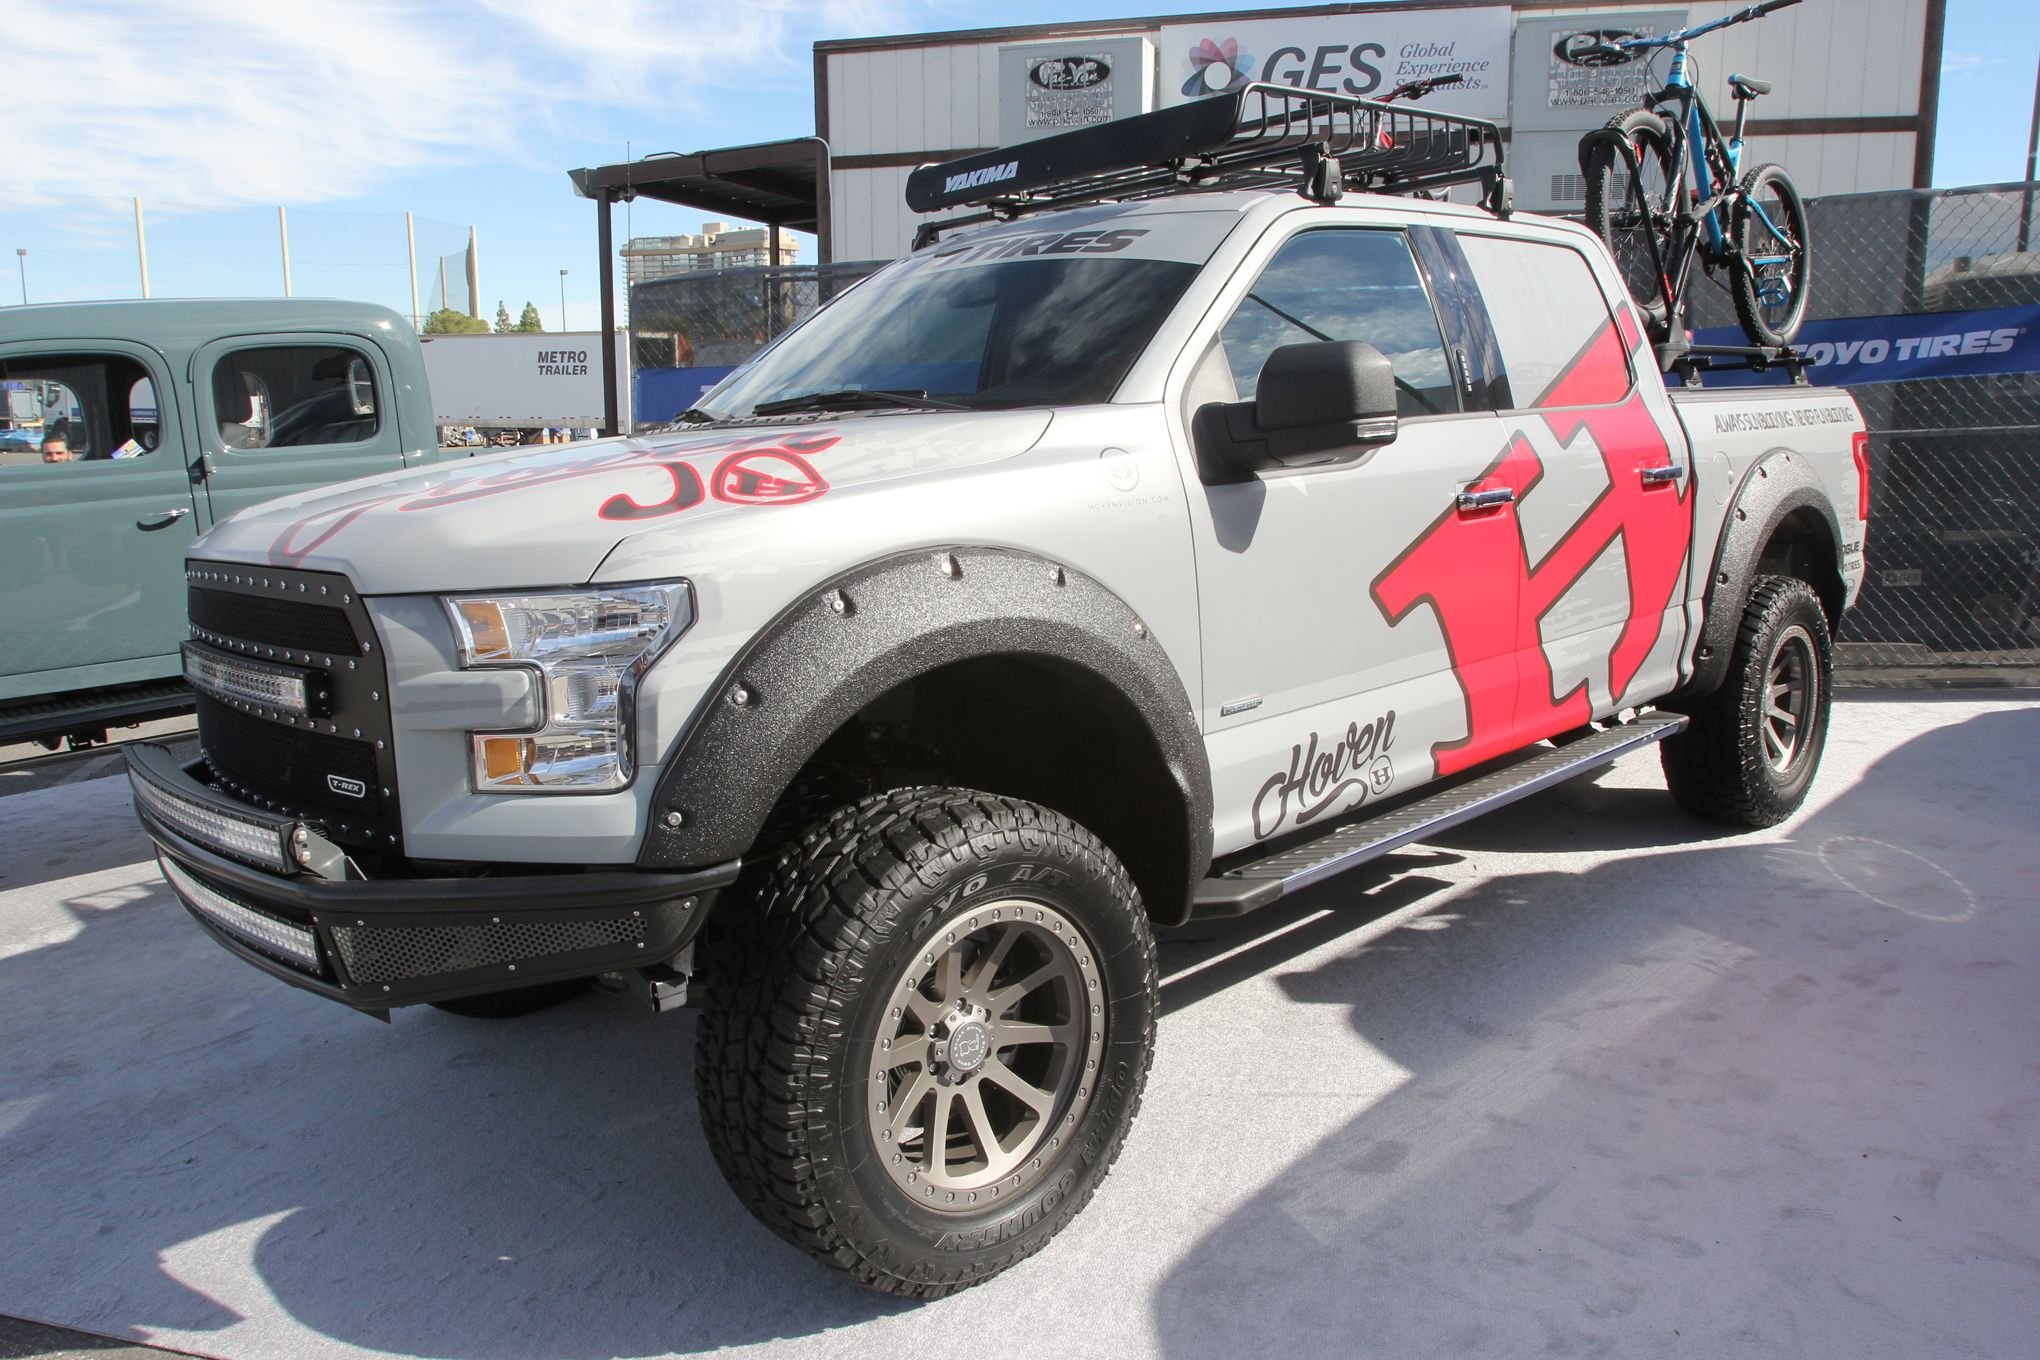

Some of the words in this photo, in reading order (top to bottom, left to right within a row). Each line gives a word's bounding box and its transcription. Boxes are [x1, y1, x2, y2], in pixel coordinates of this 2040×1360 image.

[1400, 41, 1456, 58] Global
[1261, 42, 1386, 98] GES
[1395, 58, 1490, 77] Experience
[943, 161, 1019, 193] YAKIMA
[538, 351, 588, 364] METRO
[1895, 328, 2019, 361] TIRES
[538, 365, 588, 376] TRAILER
[332, 780, 360, 792] T-REX
[1252, 710, 1396, 840] Hoven
[911, 872, 988, 941] OYO
[934, 1169, 1076, 1252] COUNTRY
